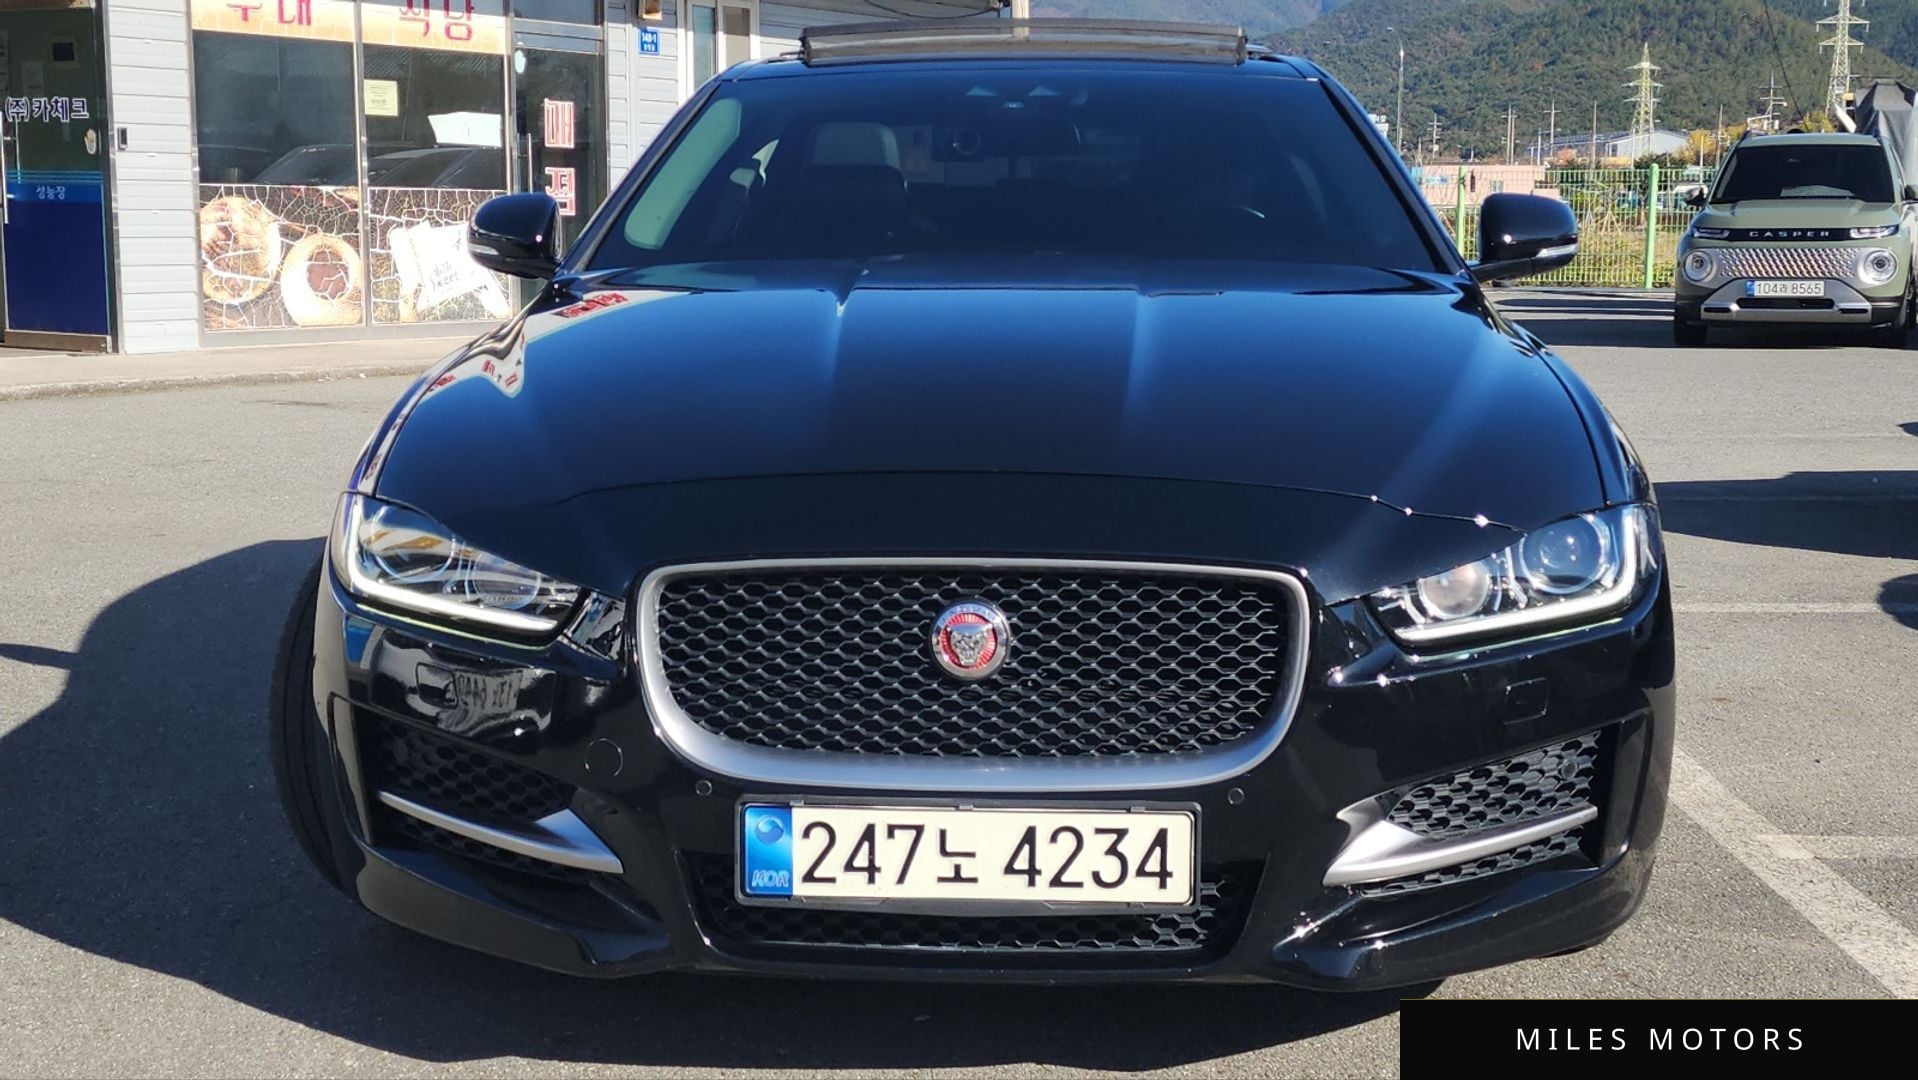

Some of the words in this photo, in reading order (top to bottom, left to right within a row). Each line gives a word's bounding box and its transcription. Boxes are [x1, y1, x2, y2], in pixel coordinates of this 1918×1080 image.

[4, 96, 90, 123] (주)카체크
[544, 98, 576, 216] 매점
[36, 185, 67, 200] 성능장
[1791, 282, 1822, 295] 8565
[800, 820, 979, 885] 247노
[1003, 825, 1174, 890] 4234
[751, 869, 790, 888] KOR
